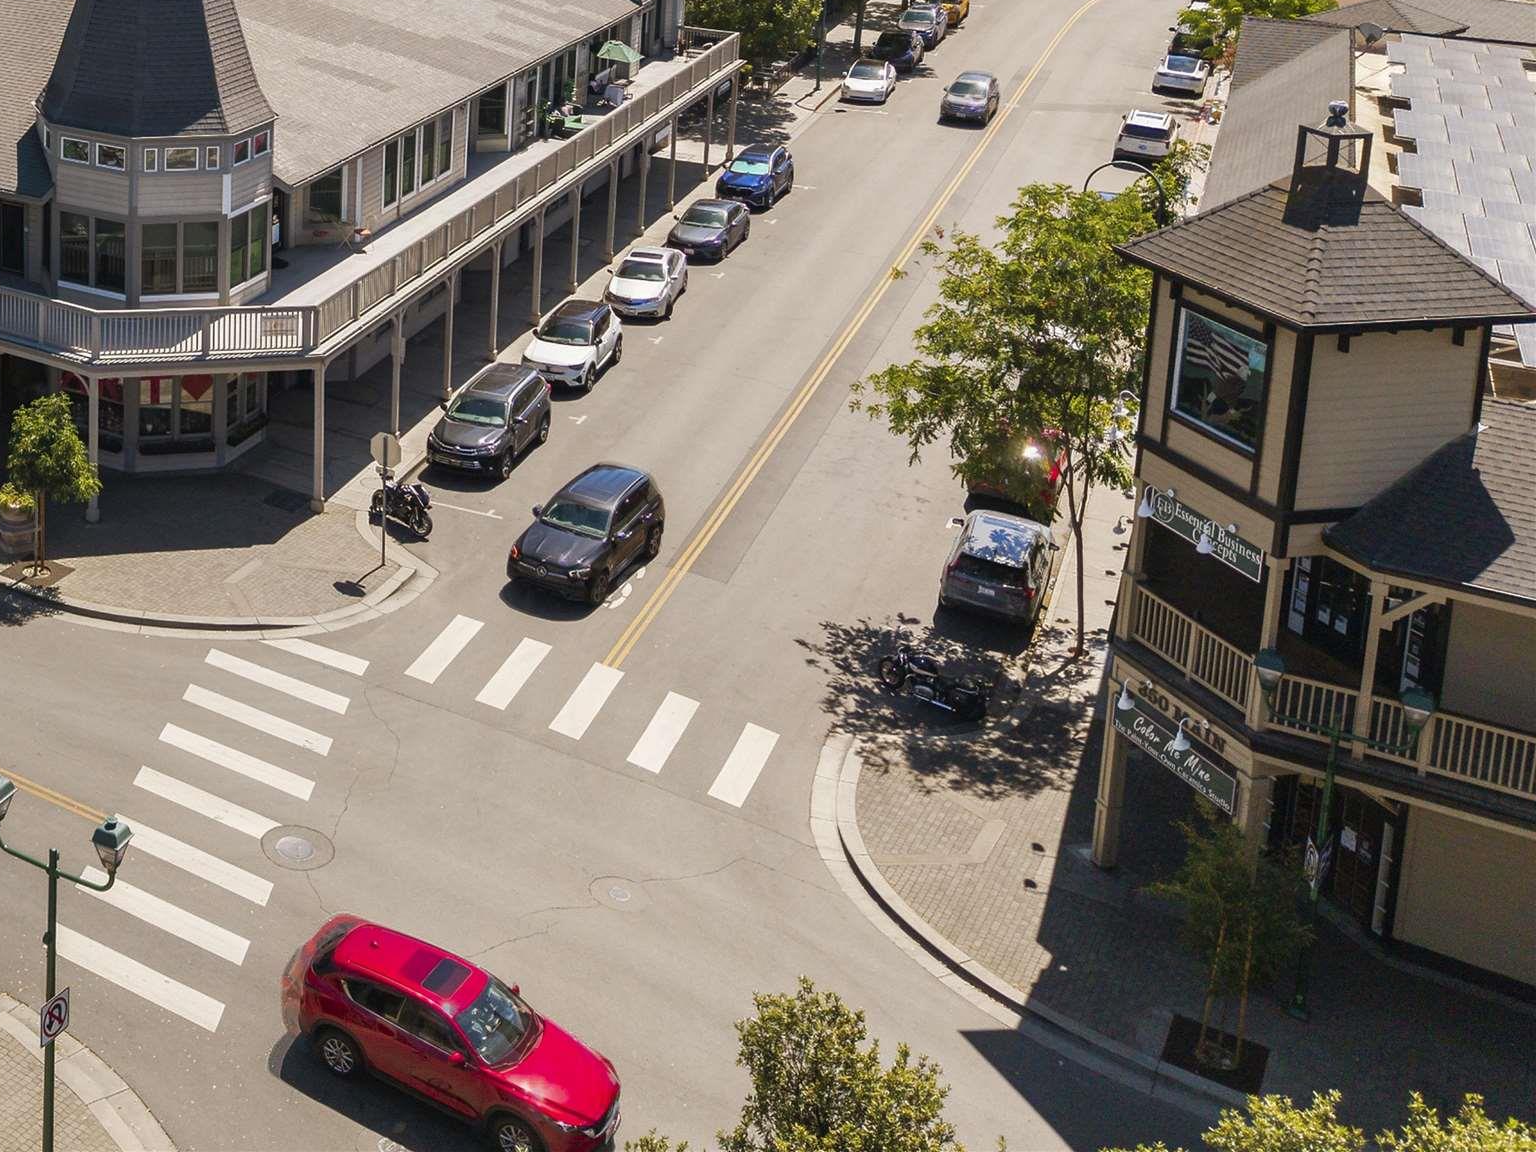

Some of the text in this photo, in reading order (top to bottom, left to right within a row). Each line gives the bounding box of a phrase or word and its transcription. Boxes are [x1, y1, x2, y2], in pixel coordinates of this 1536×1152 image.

[1175, 503, 1261, 565] Essential Business
[1192, 528, 1237, 563] Ccepts
[1115, 719, 1125, 732] The
[1208, 789, 1231, 810] Studio
[1133, 716, 1212, 782] Color Me Mine
